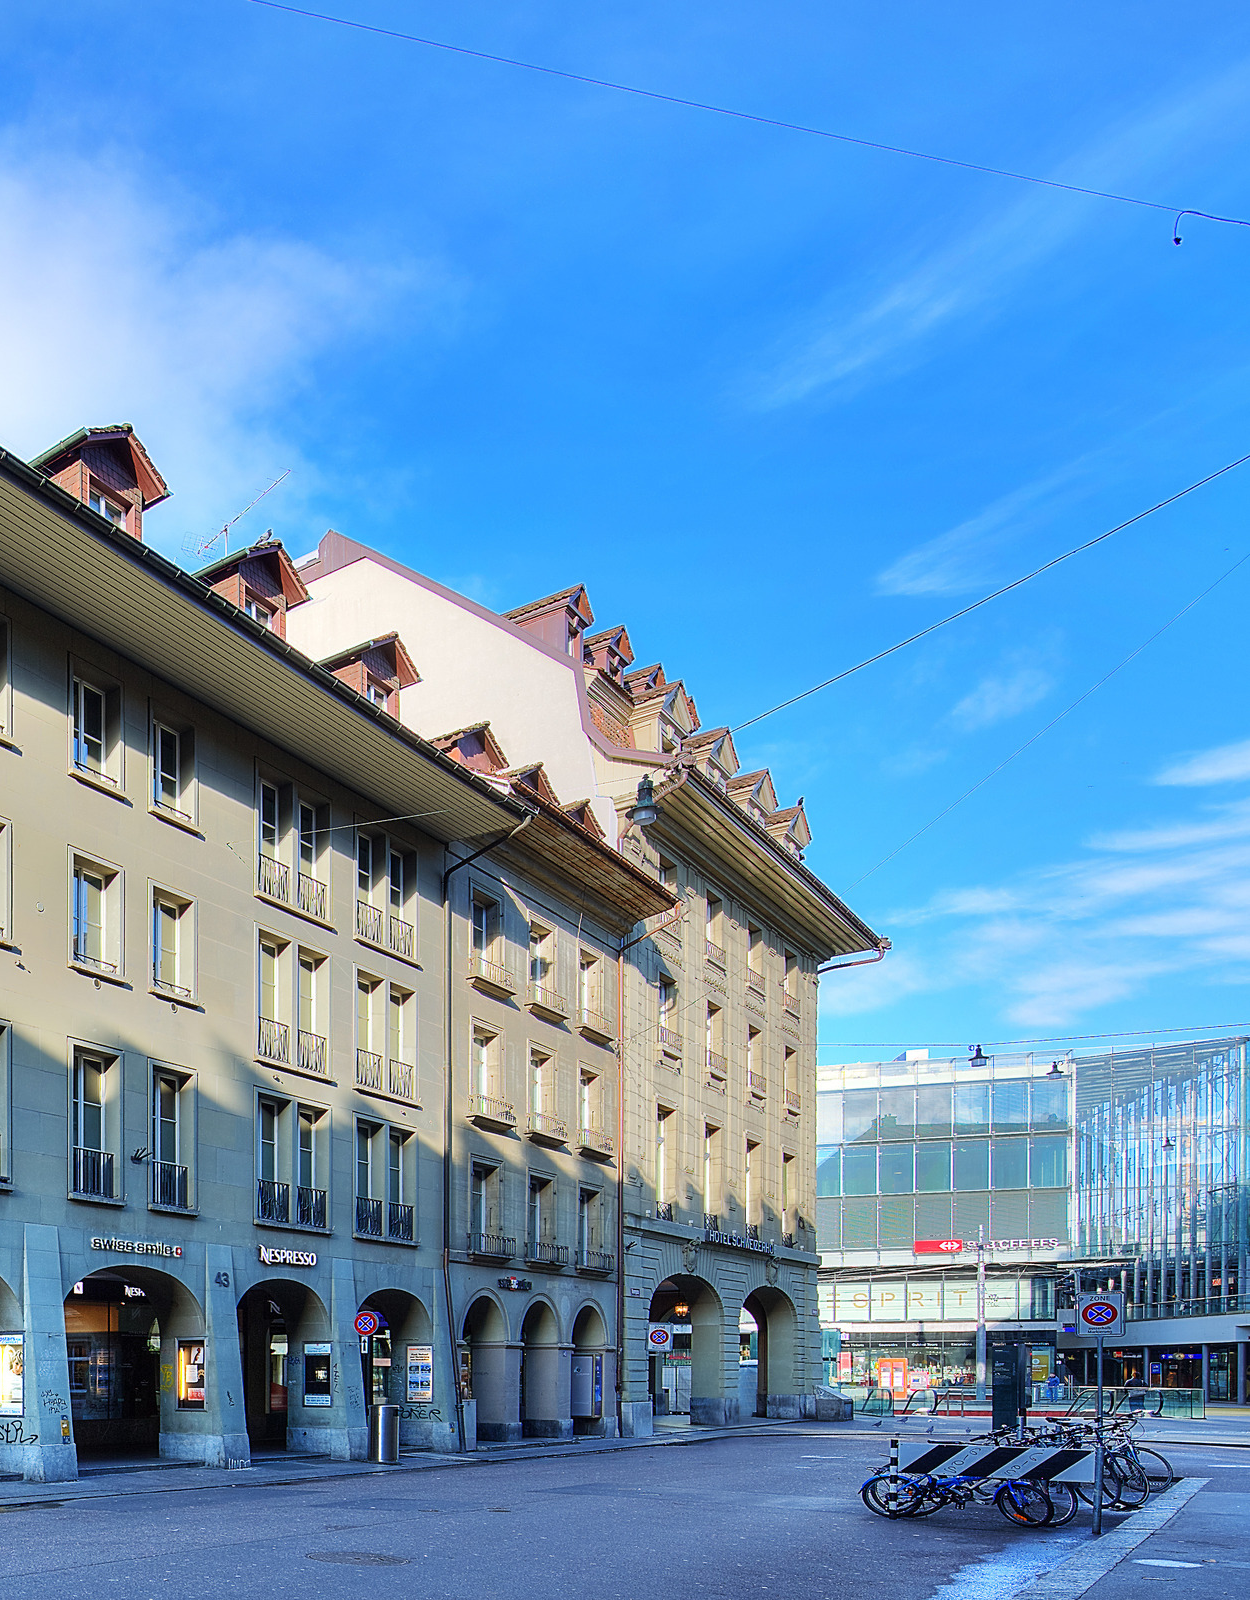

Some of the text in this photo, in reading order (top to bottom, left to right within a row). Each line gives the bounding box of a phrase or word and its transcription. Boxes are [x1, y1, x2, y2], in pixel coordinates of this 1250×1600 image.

[91, 1237, 174, 1257] swiss smile
[709, 1230, 731, 1246] HOTEL
[258, 1244, 317, 1266] NESPRESSO
[214, 1271, 230, 1288] 43
[826, 1290, 968, 1309] ESPRIT
